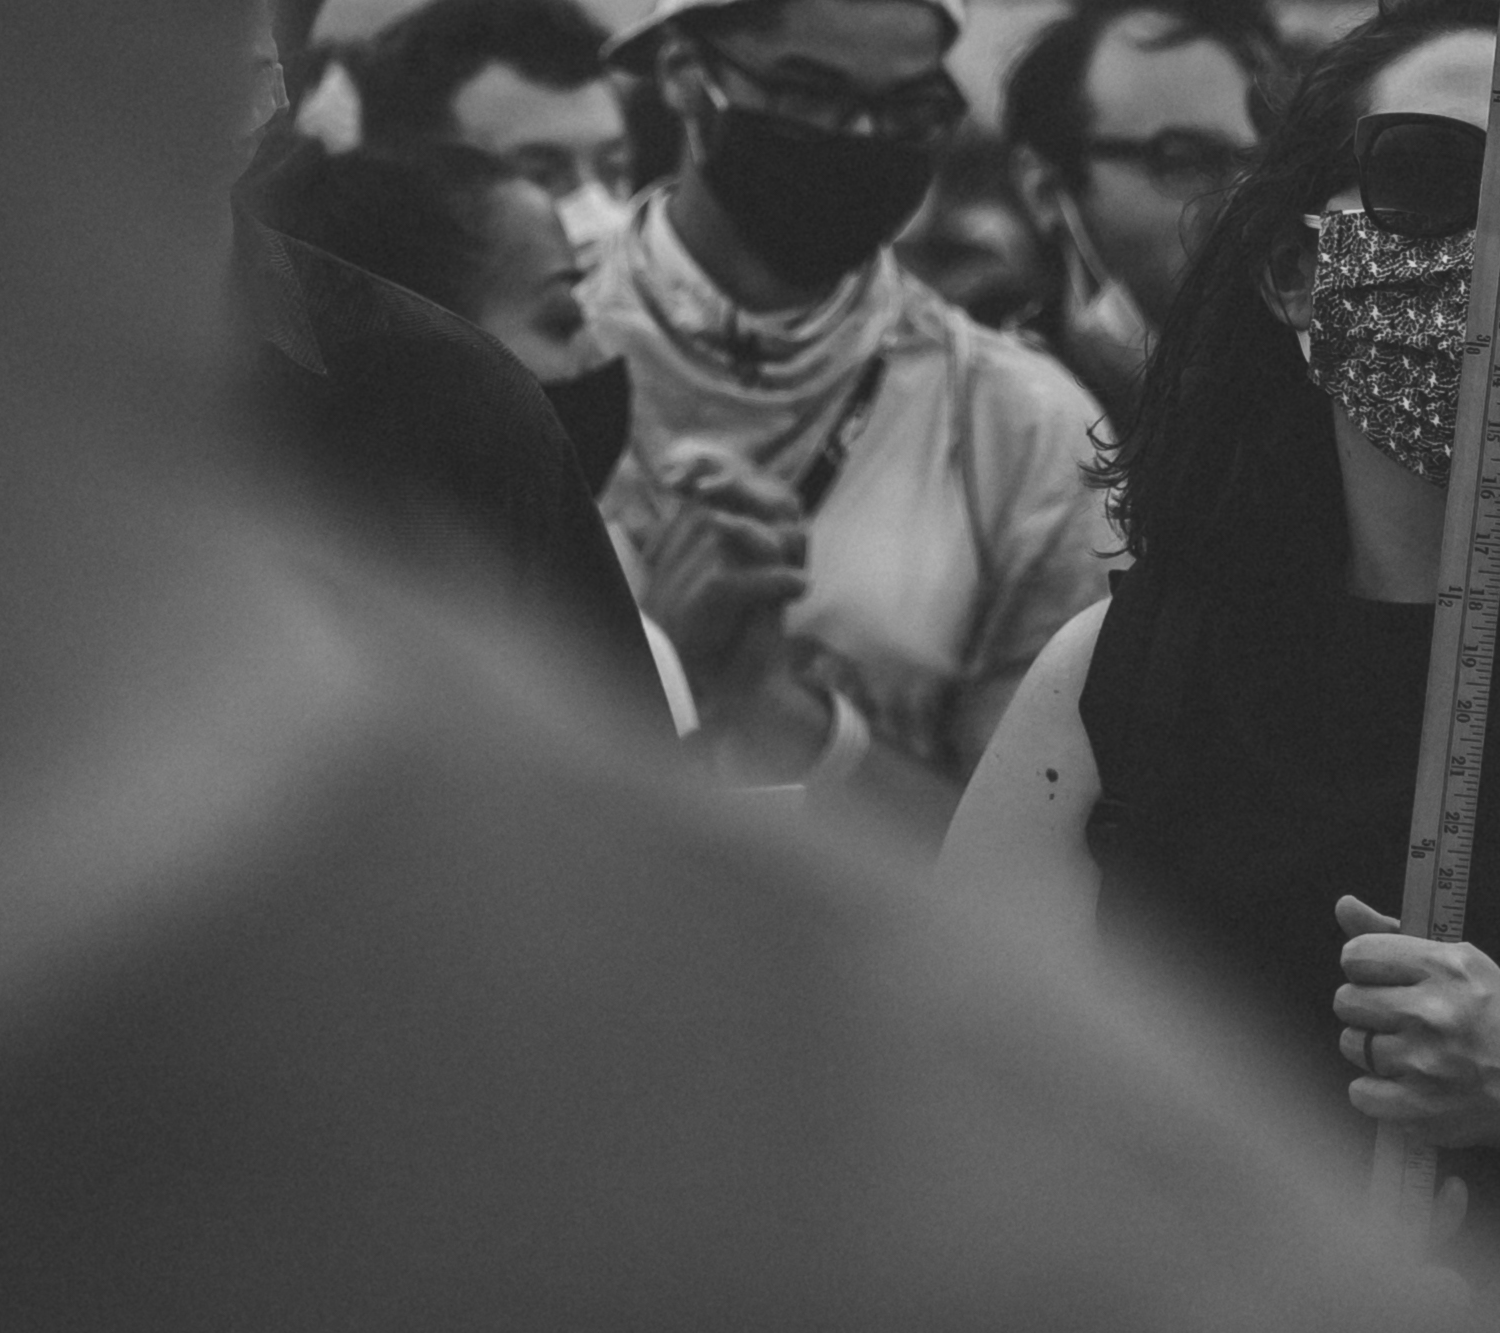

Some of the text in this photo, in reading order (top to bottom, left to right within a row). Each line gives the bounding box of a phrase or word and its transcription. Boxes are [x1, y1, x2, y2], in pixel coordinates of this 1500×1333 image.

[1480, 476, 1497, 499] 16
[1474, 532, 1490, 555] 17
[1468, 588, 1485, 611] 18
[1461, 644, 1478, 668] 19
[1455, 699, 1472, 723] 20
[1449, 755, 1466, 776] 21
[1443, 811, 1460, 834] 22
[1437, 867, 1454, 891] 23
